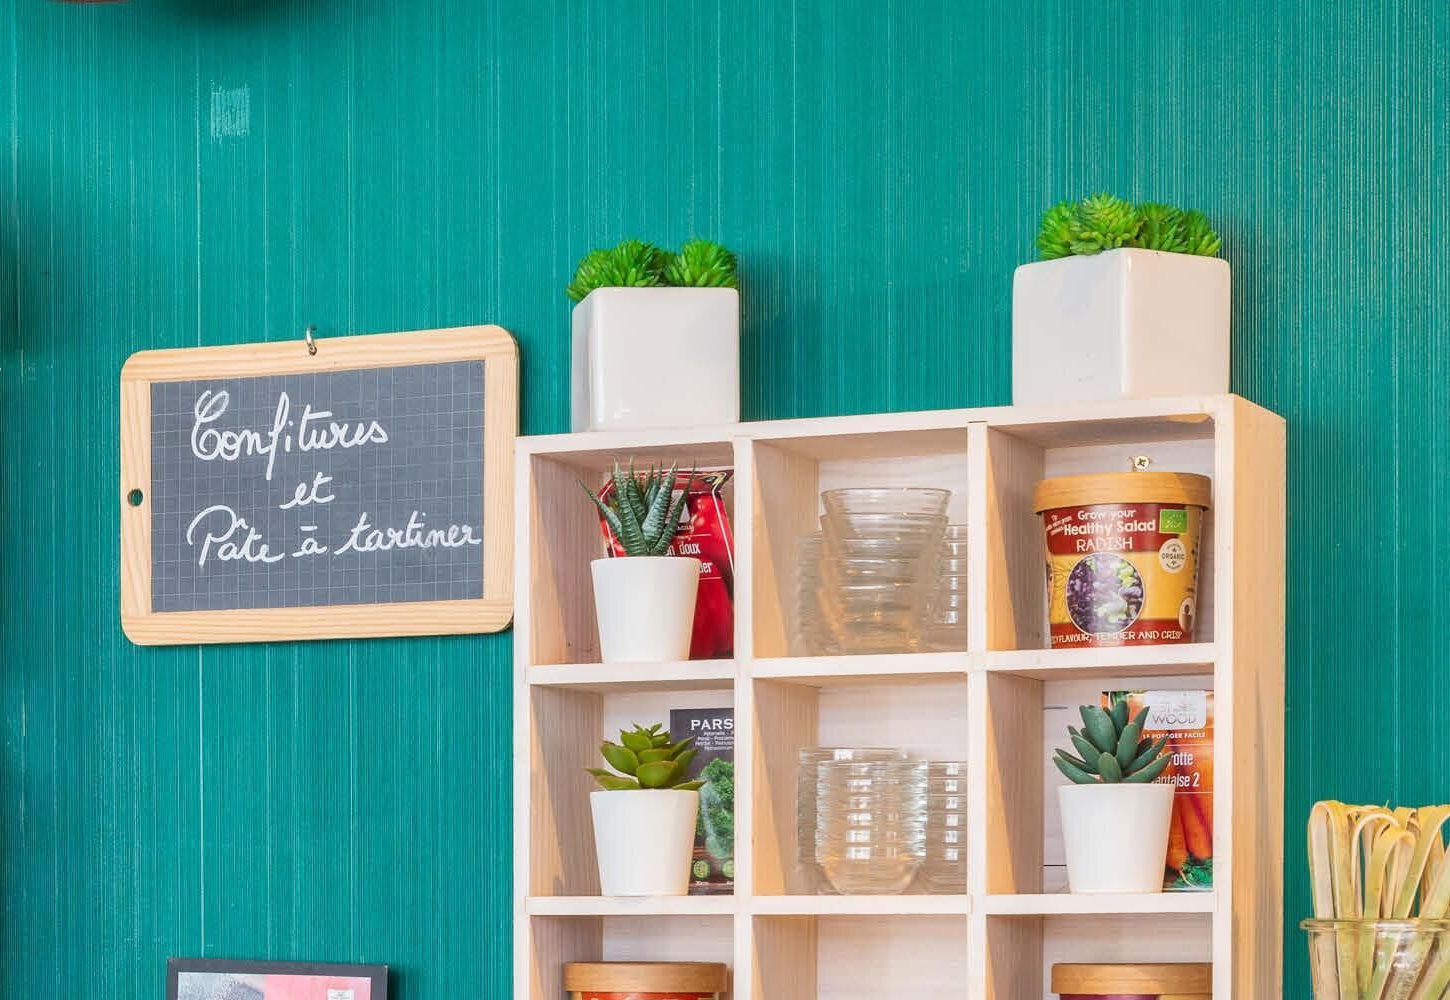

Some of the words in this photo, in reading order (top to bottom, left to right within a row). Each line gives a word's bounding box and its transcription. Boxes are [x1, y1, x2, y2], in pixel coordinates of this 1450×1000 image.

[191, 390, 389, 481] Confitures
[279, 471, 335, 510] et
[1078, 509, 1108, 521] Grow
[1109, 509, 1137, 521] your
[334, 511, 482, 556] tartiner
[1064, 521, 1113, 537] Healthy
[1116, 519, 1156, 533] Salad
[1076, 536, 1134, 553] RADISH
[1161, 552, 1185, 561] ORGANIC
[1137, 630, 1161, 640] AND
[690, 718, 734, 731] PARS
[1151, 712, 1198, 725] WOOD
[1151, 732, 1183, 740] POTGER
[1183, 731, 1207, 739] FACILE
[1191, 771, 1201, 788] 2
